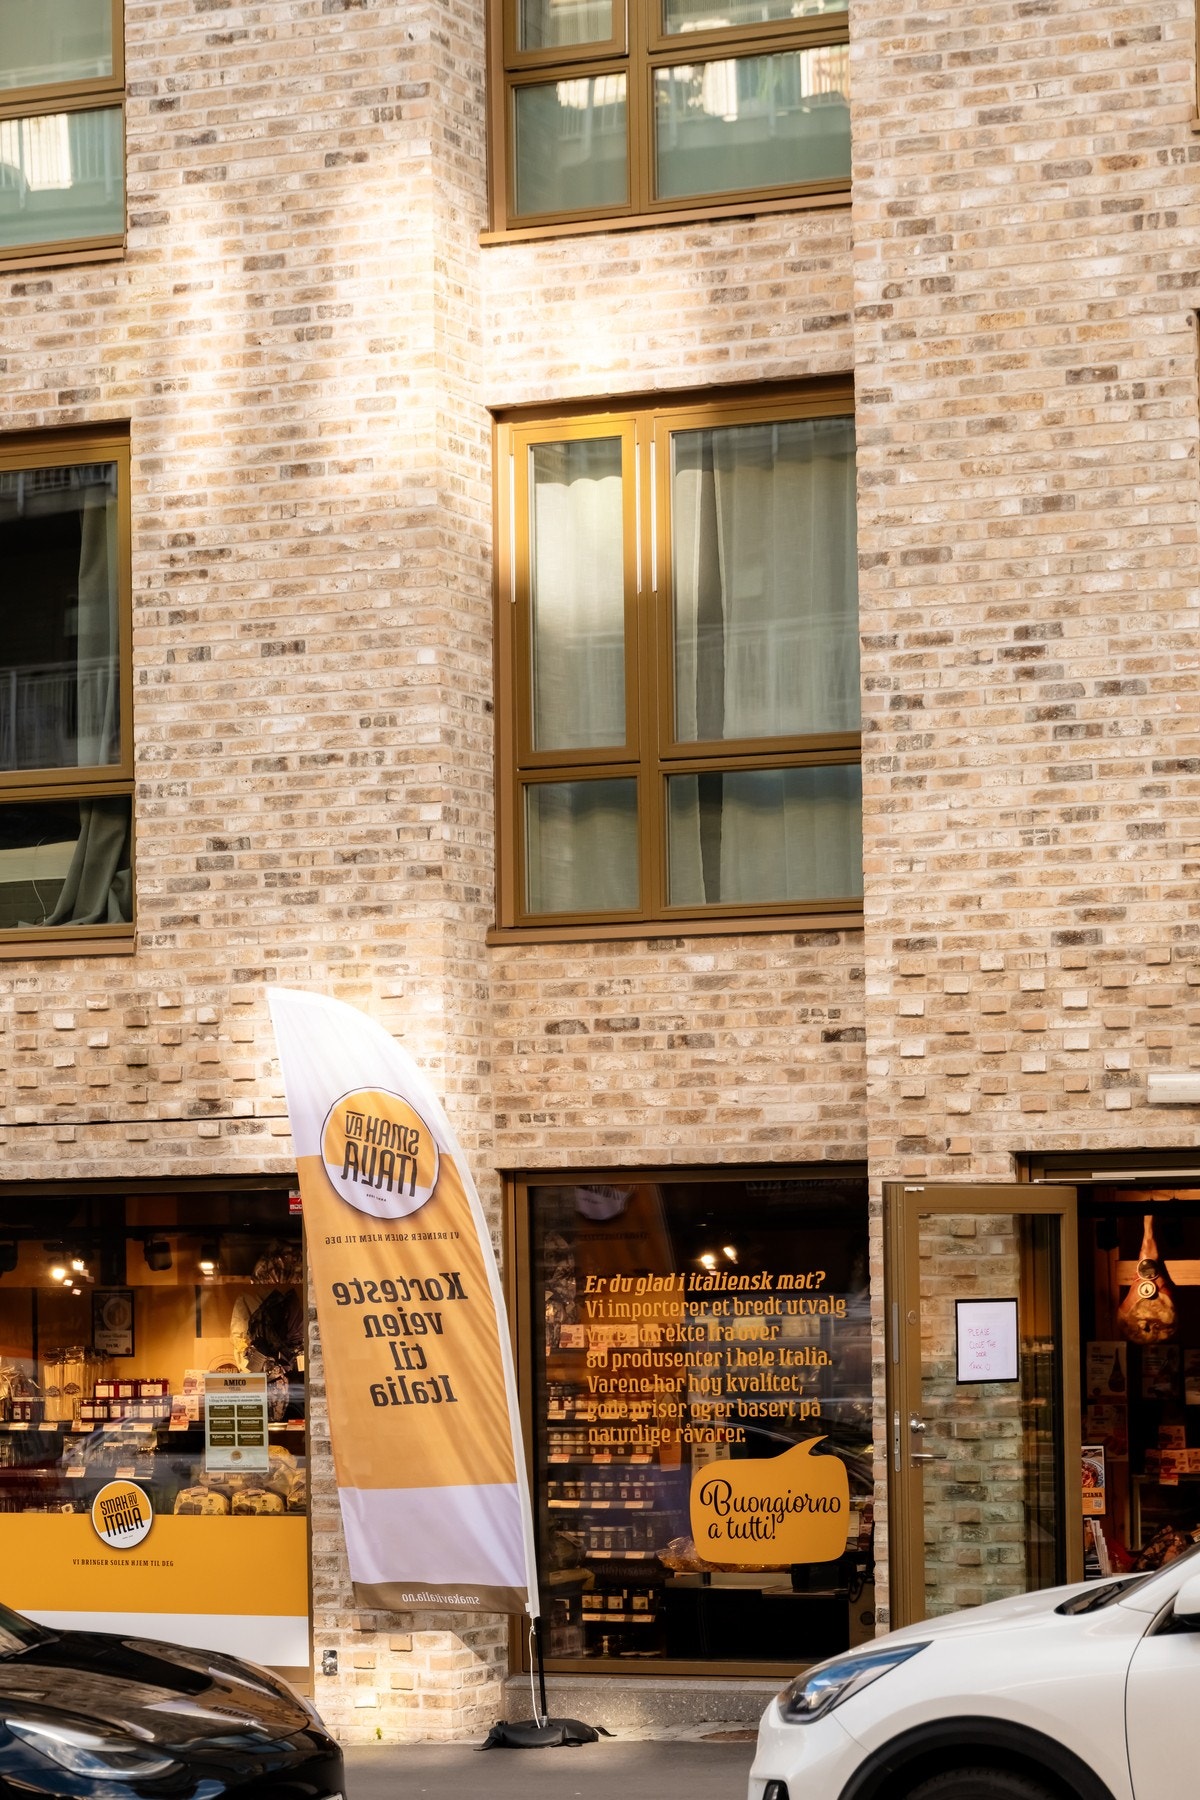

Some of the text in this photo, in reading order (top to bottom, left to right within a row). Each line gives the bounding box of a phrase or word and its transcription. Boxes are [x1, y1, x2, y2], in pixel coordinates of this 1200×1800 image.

[583, 1270, 826, 1296] Er du glad i italiensk mat?
[585, 1295, 847, 1322] Vi importerer et bredt utvalg
[640, 1323, 705, 1343] direkte
[707, 1322, 735, 1342] fra
[739, 1324, 780, 1341] over
[586, 1346, 833, 1372] 80 produsenter i hele Italia.
[223, 1379, 247, 1387] AMICO
[586, 1372, 803, 1397] Varene har høy kvalitet,
[587, 1397, 821, 1423] gode priser og er basert på
[588, 1422, 747, 1447] naturlige råvarer.
[100, 1493, 138, 1516] SMAK AV
[700, 1478, 842, 1524] Buongiorno
[103, 1507, 145, 1538] ITALIA
[708, 1513, 776, 1542] a tutti!
[72, 1558, 80, 1566] VI
[81, 1558, 109, 1566] BRINGER
[131, 1559, 149, 1567] HJEM
[150, 1559, 161, 1567] TIL
[161, 1560, 174, 1568] DEG
